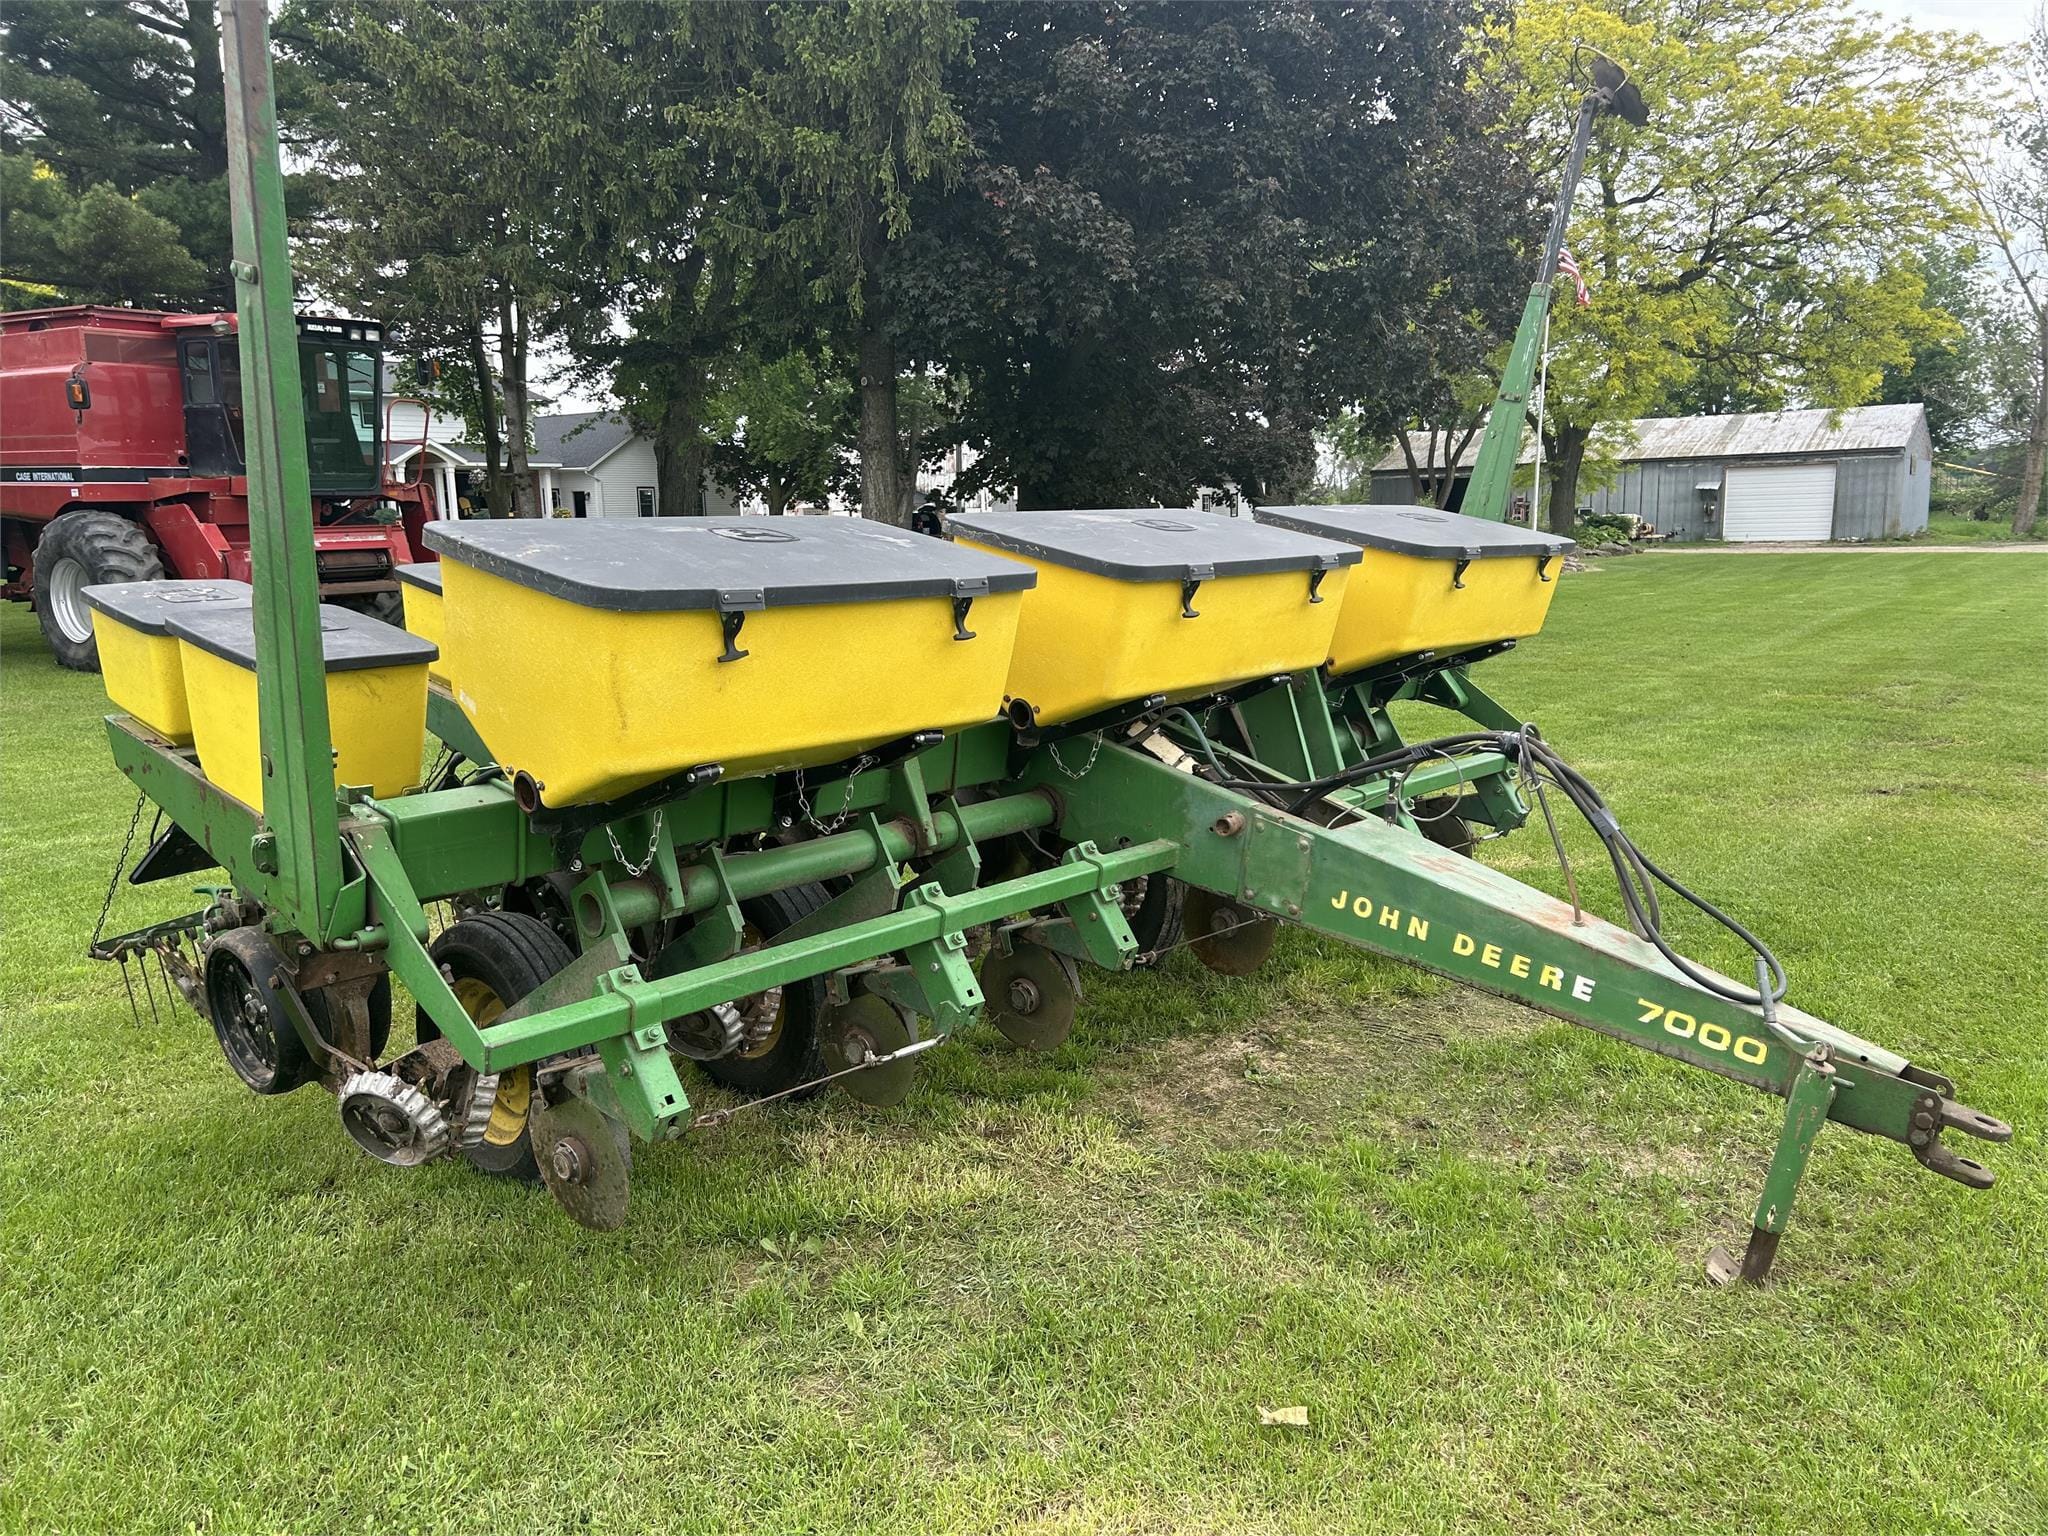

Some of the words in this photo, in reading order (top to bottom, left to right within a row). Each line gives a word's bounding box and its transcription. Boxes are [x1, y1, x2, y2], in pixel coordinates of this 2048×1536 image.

[15, 472, 31, 481] CASE
[32, 472, 75, 481] INTERNATIONAL
[1331, 890, 1429, 941] JOHN
[1452, 933, 1596, 1002] DEERE
[1637, 998, 1768, 1065] 7000
